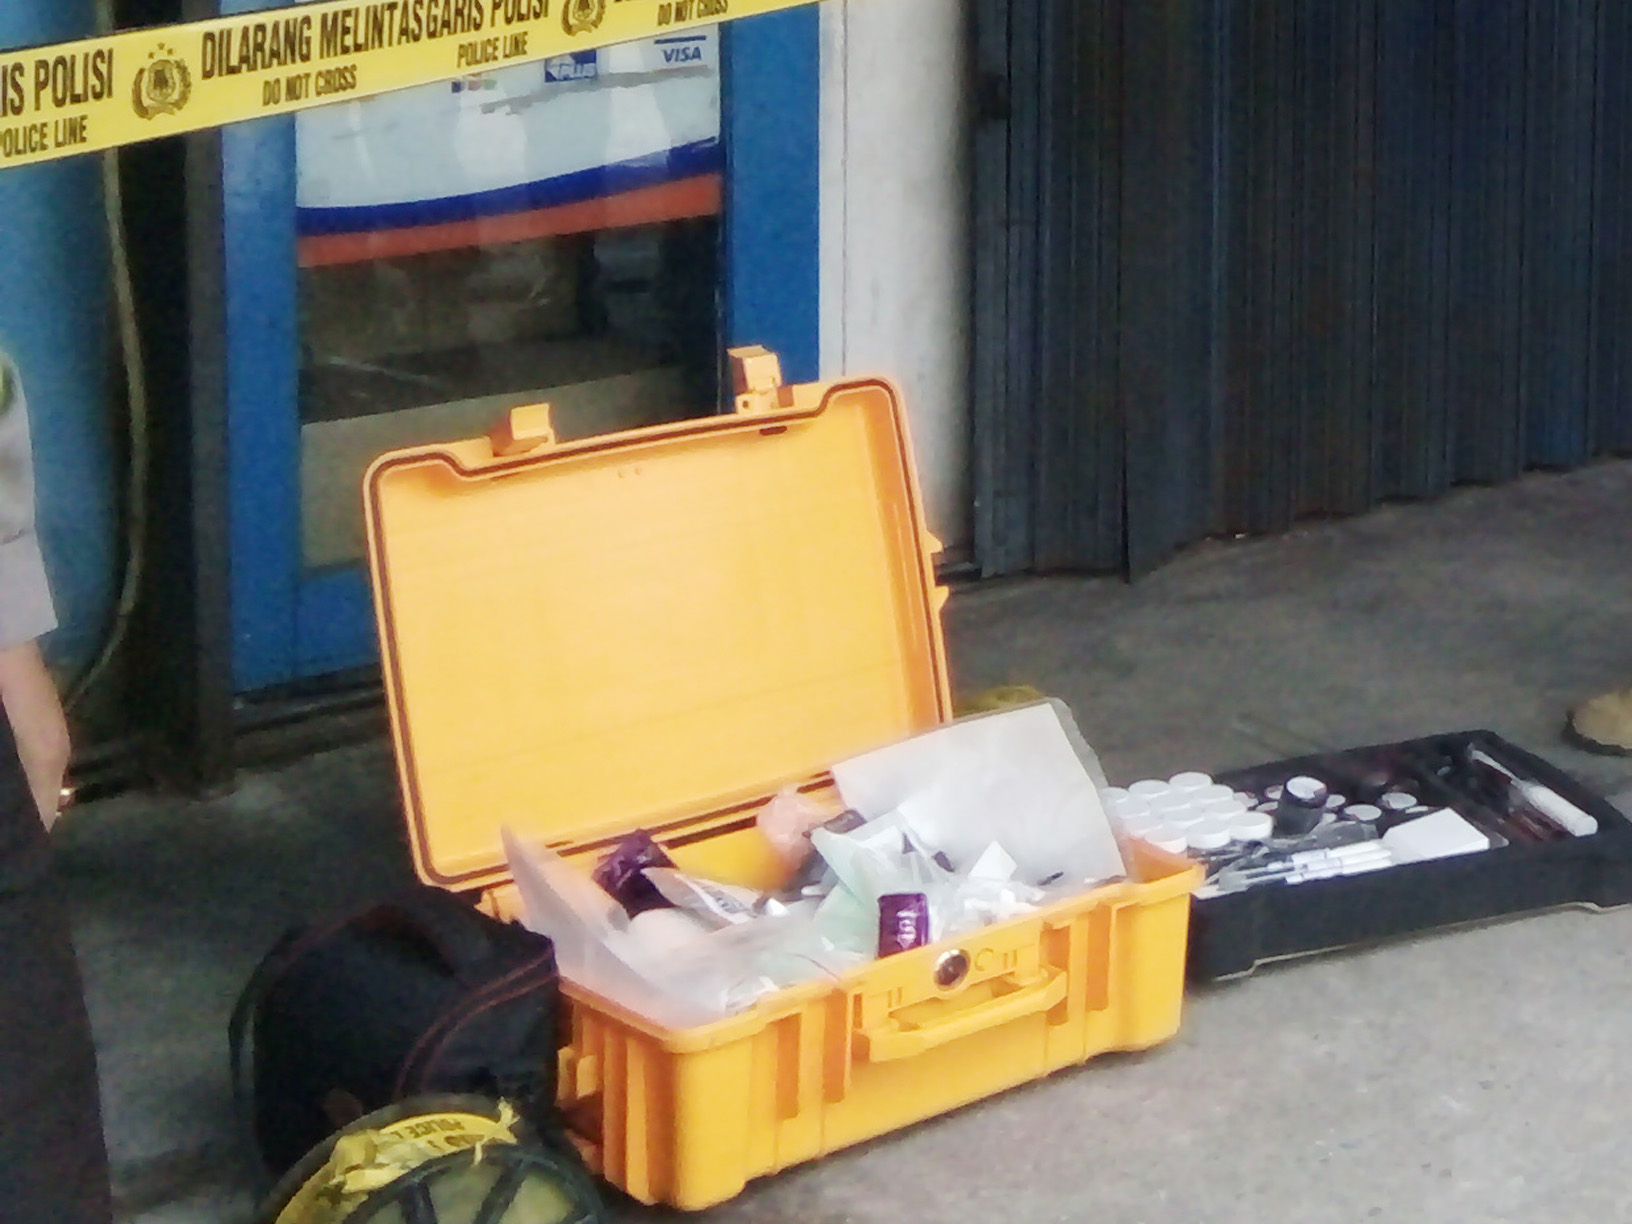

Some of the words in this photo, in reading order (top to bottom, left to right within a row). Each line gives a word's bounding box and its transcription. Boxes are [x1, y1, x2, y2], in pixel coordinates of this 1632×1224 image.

[201, 14, 312, 80] DILARANG
[262, 79, 281, 107] DO
[285, 71, 310, 101] NOT
[315, 63, 358, 96] CROSS
[457, 36, 499, 69] POLICE
[502, 31, 529, 59] LINE
[663, 46, 703, 64] VISA
[0, 61, 25, 118] IS
[34, 47, 114, 112] POLISI
[0, 122, 48, 158] OLICE
[54, 114, 89, 148] LINE
